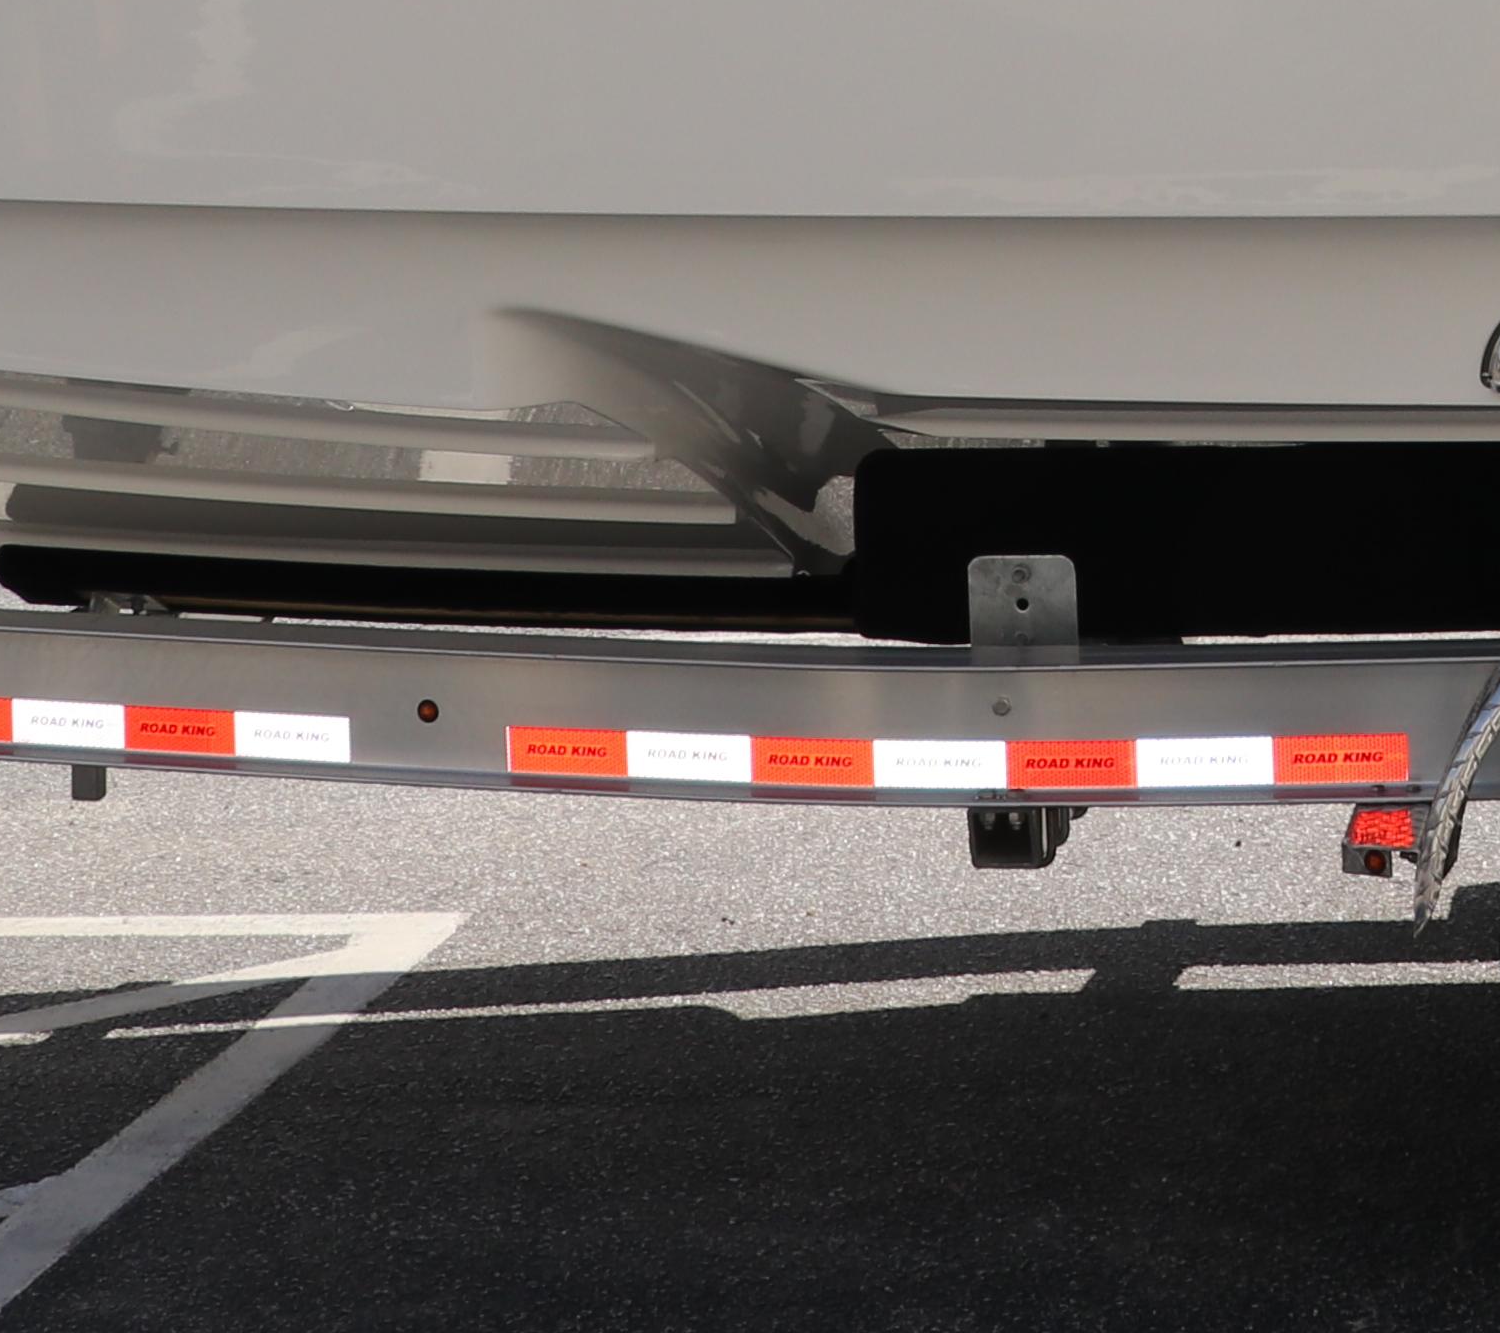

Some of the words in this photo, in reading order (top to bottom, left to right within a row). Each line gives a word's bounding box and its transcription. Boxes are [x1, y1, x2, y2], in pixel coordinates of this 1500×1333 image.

[30, 715, 67, 727] ROAD
[70, 717, 105, 730] KING
[140, 722, 178, 735] ROAD
[181, 724, 215, 737] KING
[253, 728, 293, 740] ROAD
[296, 730, 330, 743] KING
[526, 744, 568, 756] ROAD
[570, 746, 607, 758] KING
[647, 748, 688, 760] ROAD
[692, 749, 728, 762] KING
[1292, 753, 1338, 765] ROAD
[1342, 751, 1384, 764] KING
[768, 754, 811, 766] ROAD
[814, 755, 853, 768] KING
[1025, 757, 1071, 770] ROAD
[1074, 757, 1115, 769] KING
